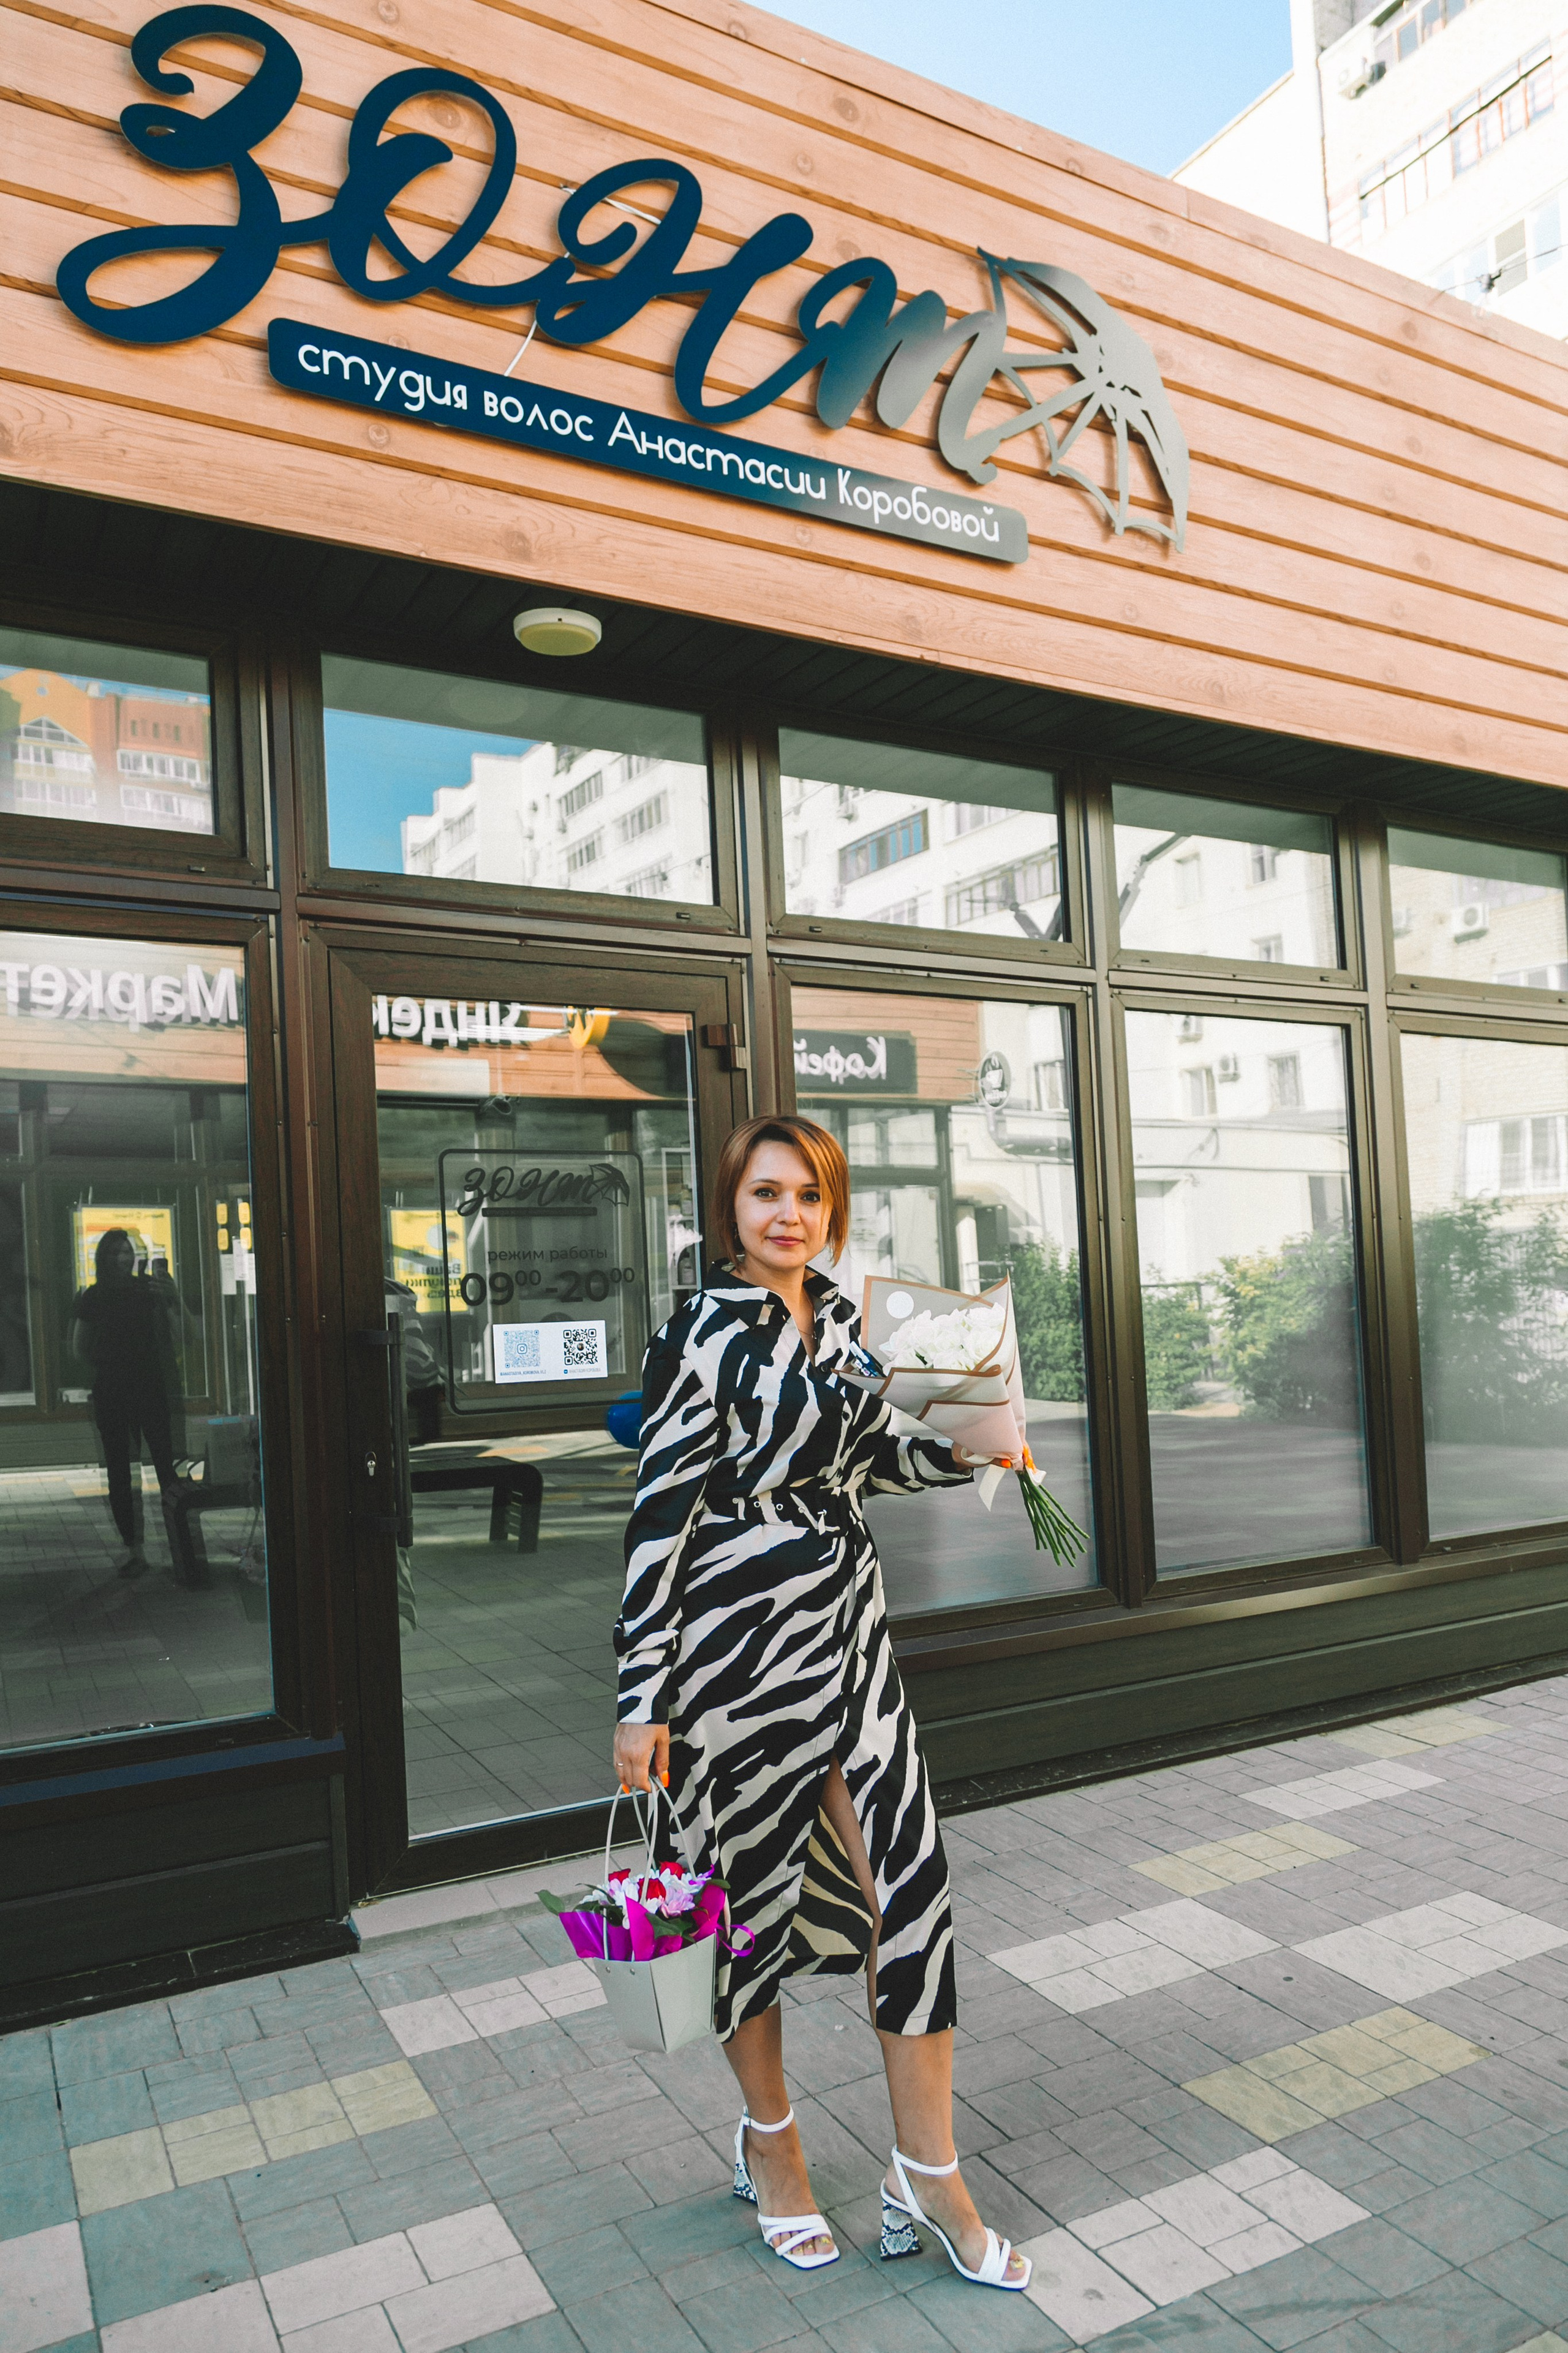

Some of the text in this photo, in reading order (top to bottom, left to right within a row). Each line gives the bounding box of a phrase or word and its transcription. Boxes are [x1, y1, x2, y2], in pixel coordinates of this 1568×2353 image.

[298, 344, 1000, 542] студия волос Анастасии Коробовой
[488, 1245, 608, 1264] режим работы
